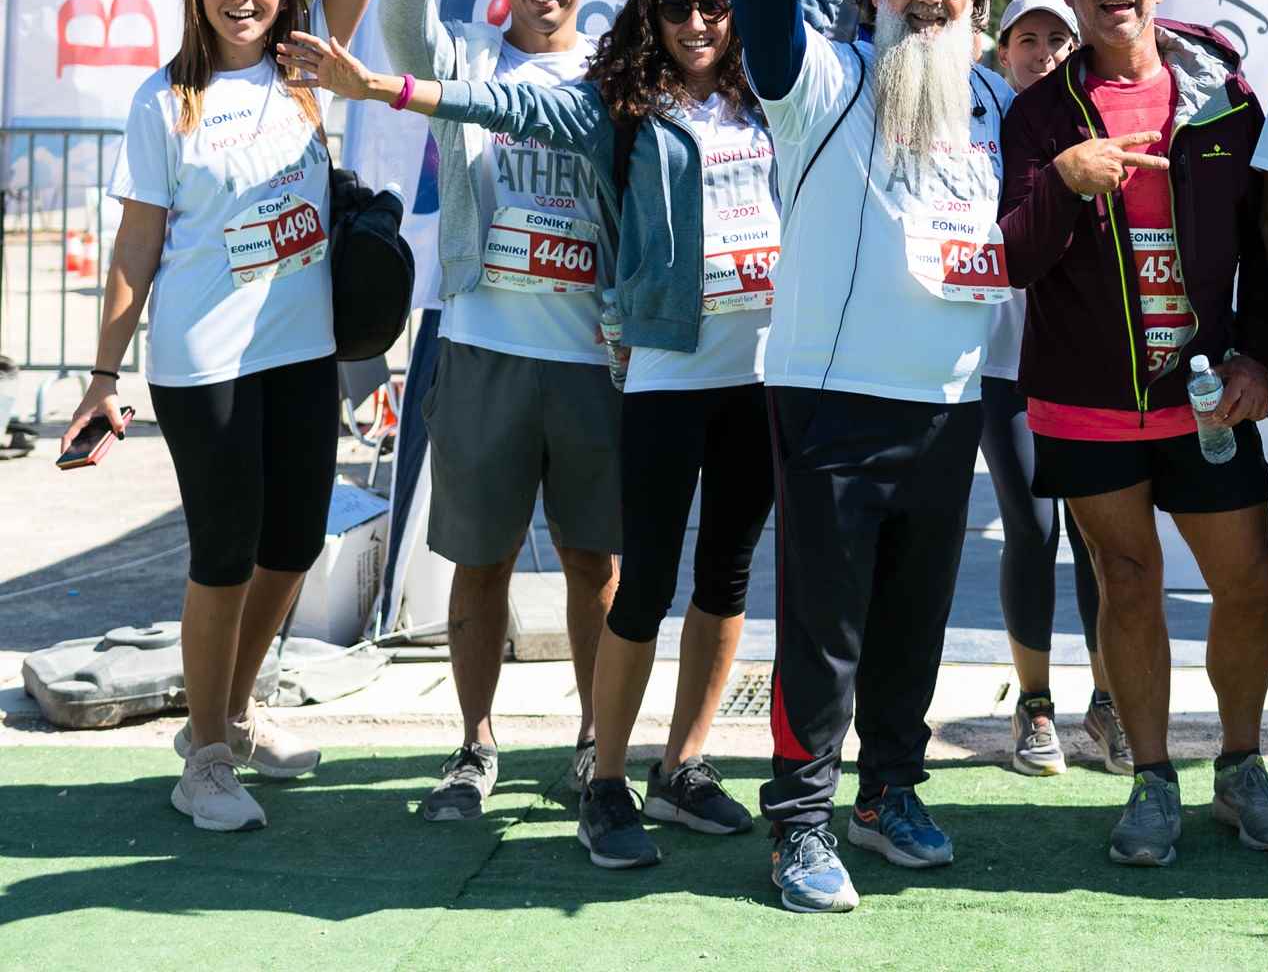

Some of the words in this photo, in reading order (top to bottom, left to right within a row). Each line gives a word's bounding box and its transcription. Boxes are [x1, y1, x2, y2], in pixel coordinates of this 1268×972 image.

[549, 197, 576, 208] 2021
[274, 207, 318, 247] 4498
[533, 239, 593, 272] 4460
[944, 244, 1000, 276] 4561
